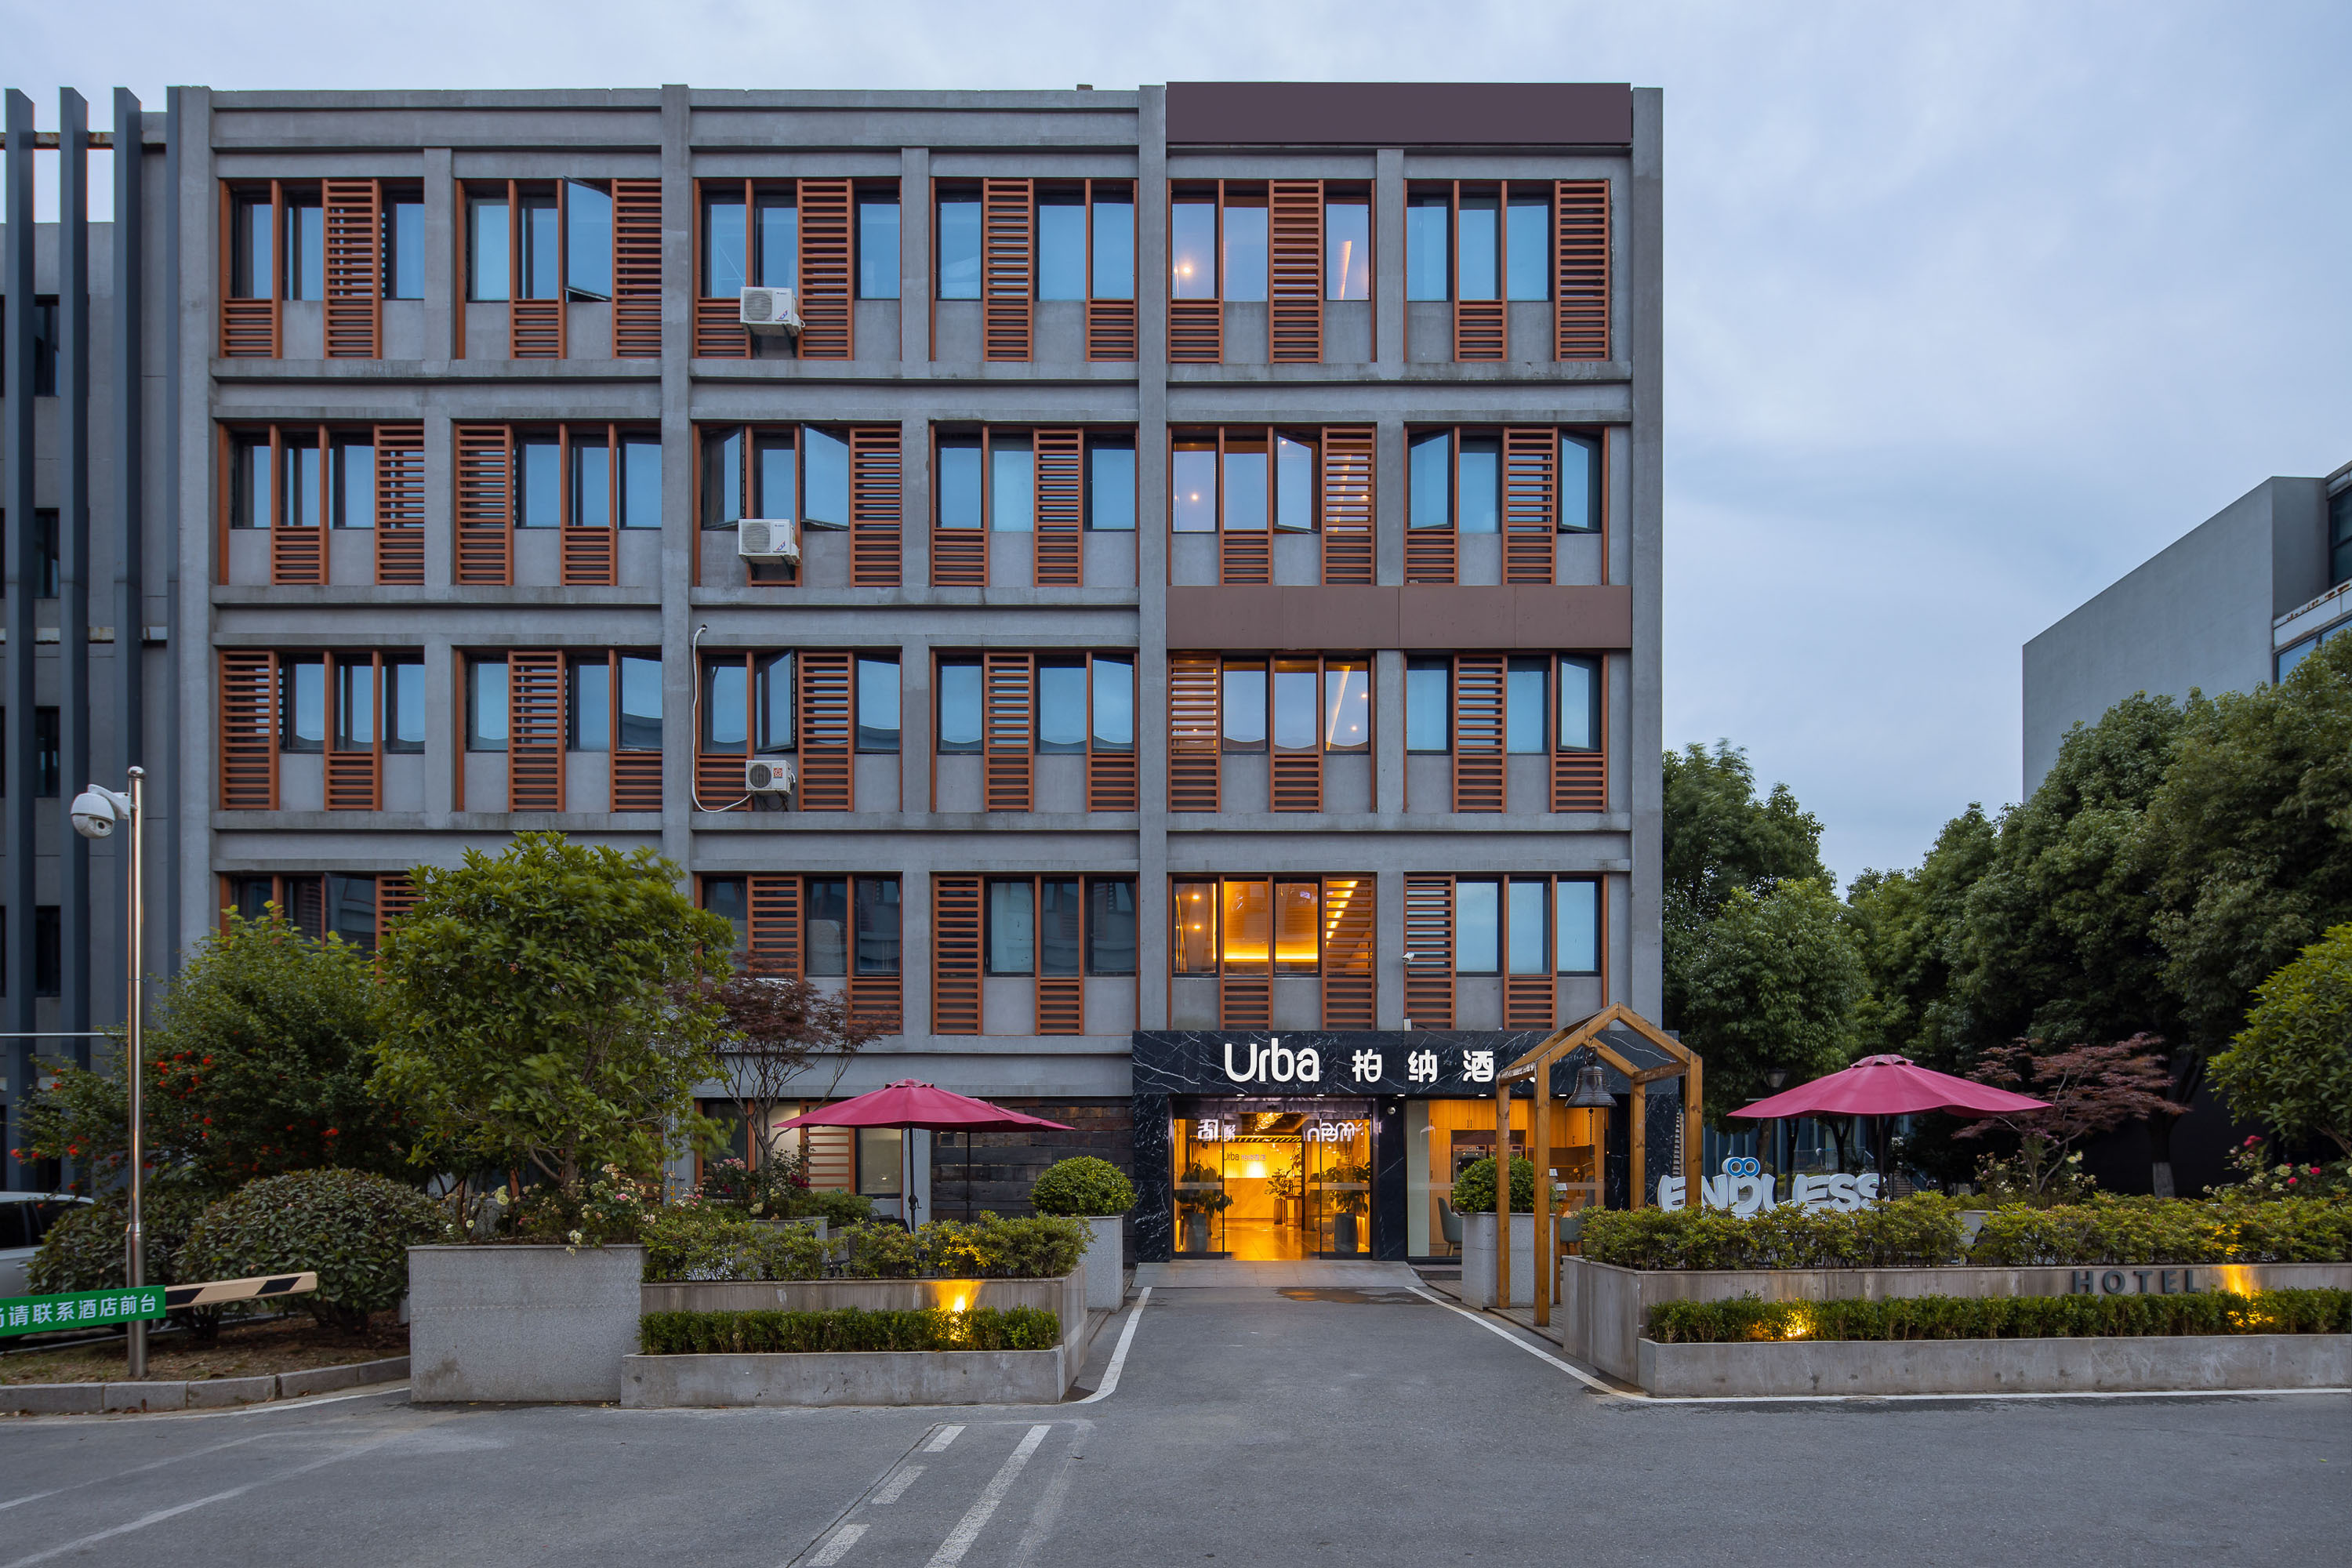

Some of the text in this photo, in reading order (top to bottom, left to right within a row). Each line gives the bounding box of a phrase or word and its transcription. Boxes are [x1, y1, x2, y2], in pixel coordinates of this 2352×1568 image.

[1225, 1038, 1536, 1083] Urba 柏纳酒
[2072, 1269, 2201, 1294] HOTEL
[0, 1294, 157, 1329] 请联系酒店前台
